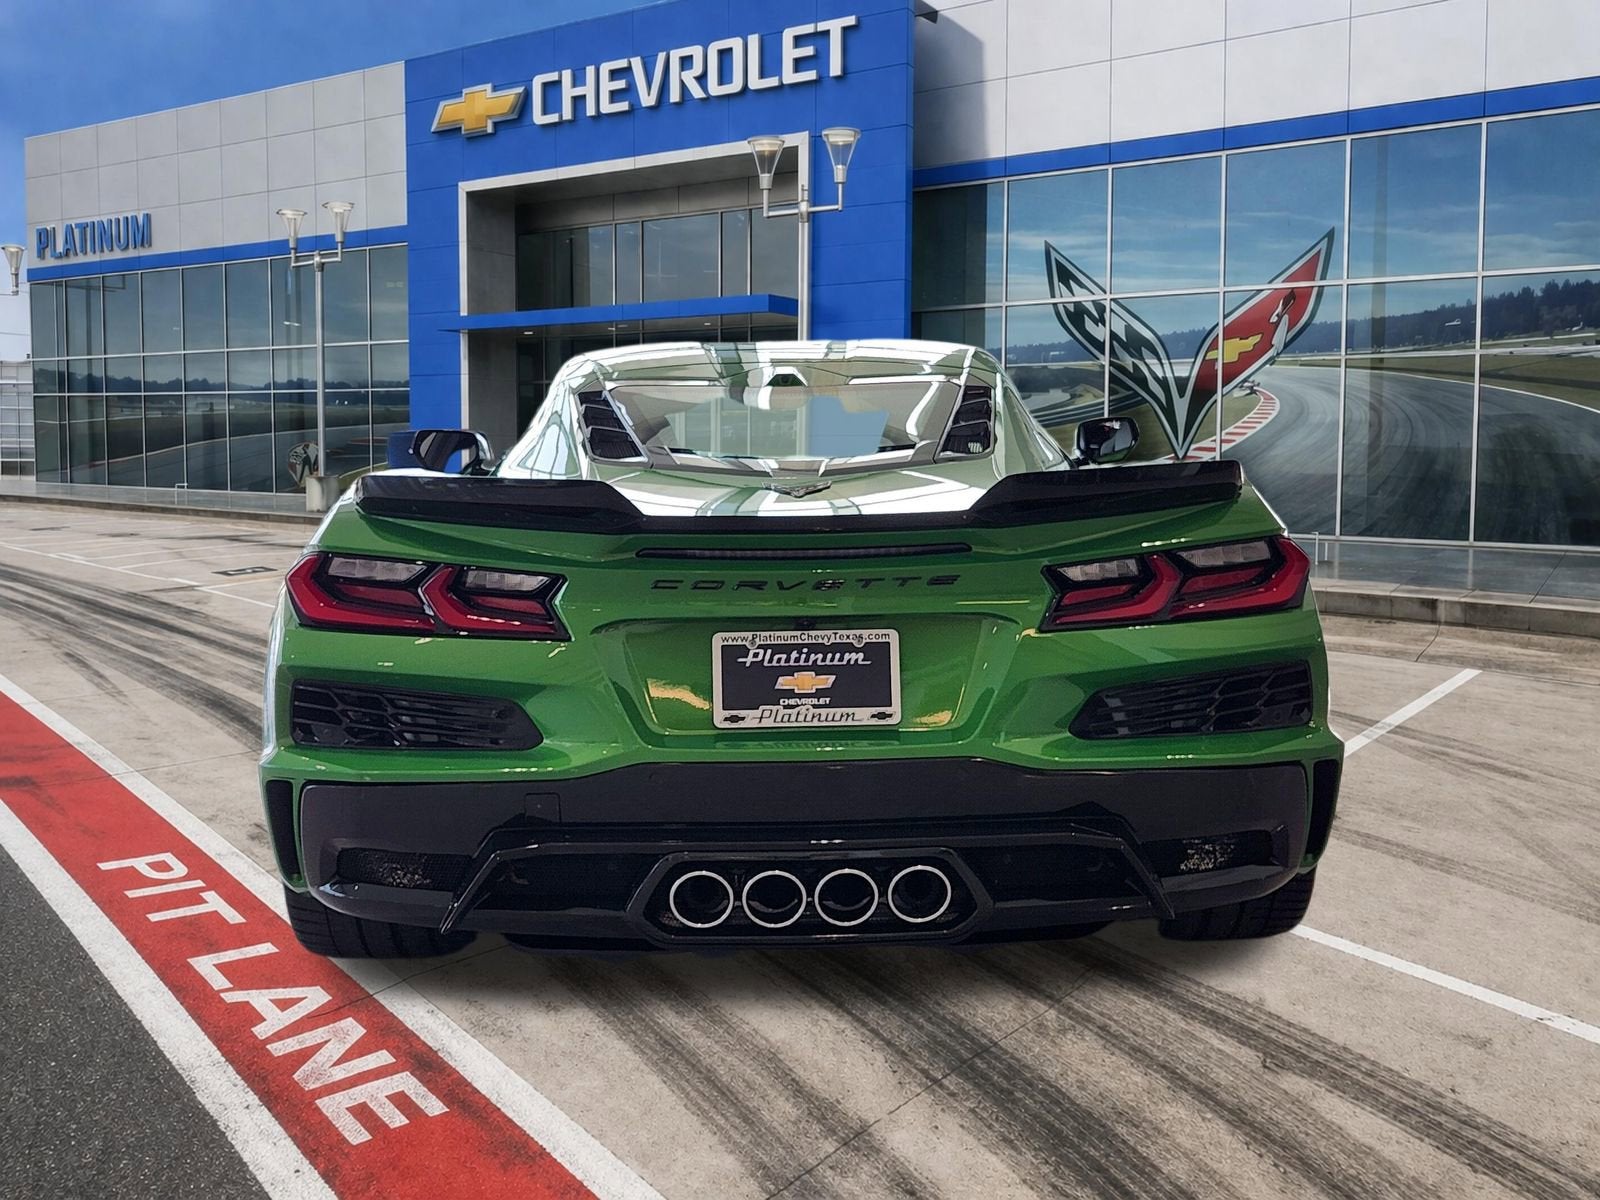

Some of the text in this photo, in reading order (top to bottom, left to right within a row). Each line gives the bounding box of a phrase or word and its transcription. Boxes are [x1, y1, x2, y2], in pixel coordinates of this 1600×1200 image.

[532, 15, 858, 126] CHEVROLET
[35, 212, 152, 259] PLATINUM
[650, 575, 960, 591] CORVETTE
[720, 632, 891, 645] www.PlatinumChevyTexas.com
[737, 648, 872, 667] Platinum
[779, 697, 831, 706] CHEVROLET
[751, 706, 864, 724] Platinum
[96, 852, 450, 1146] PIT LANE
